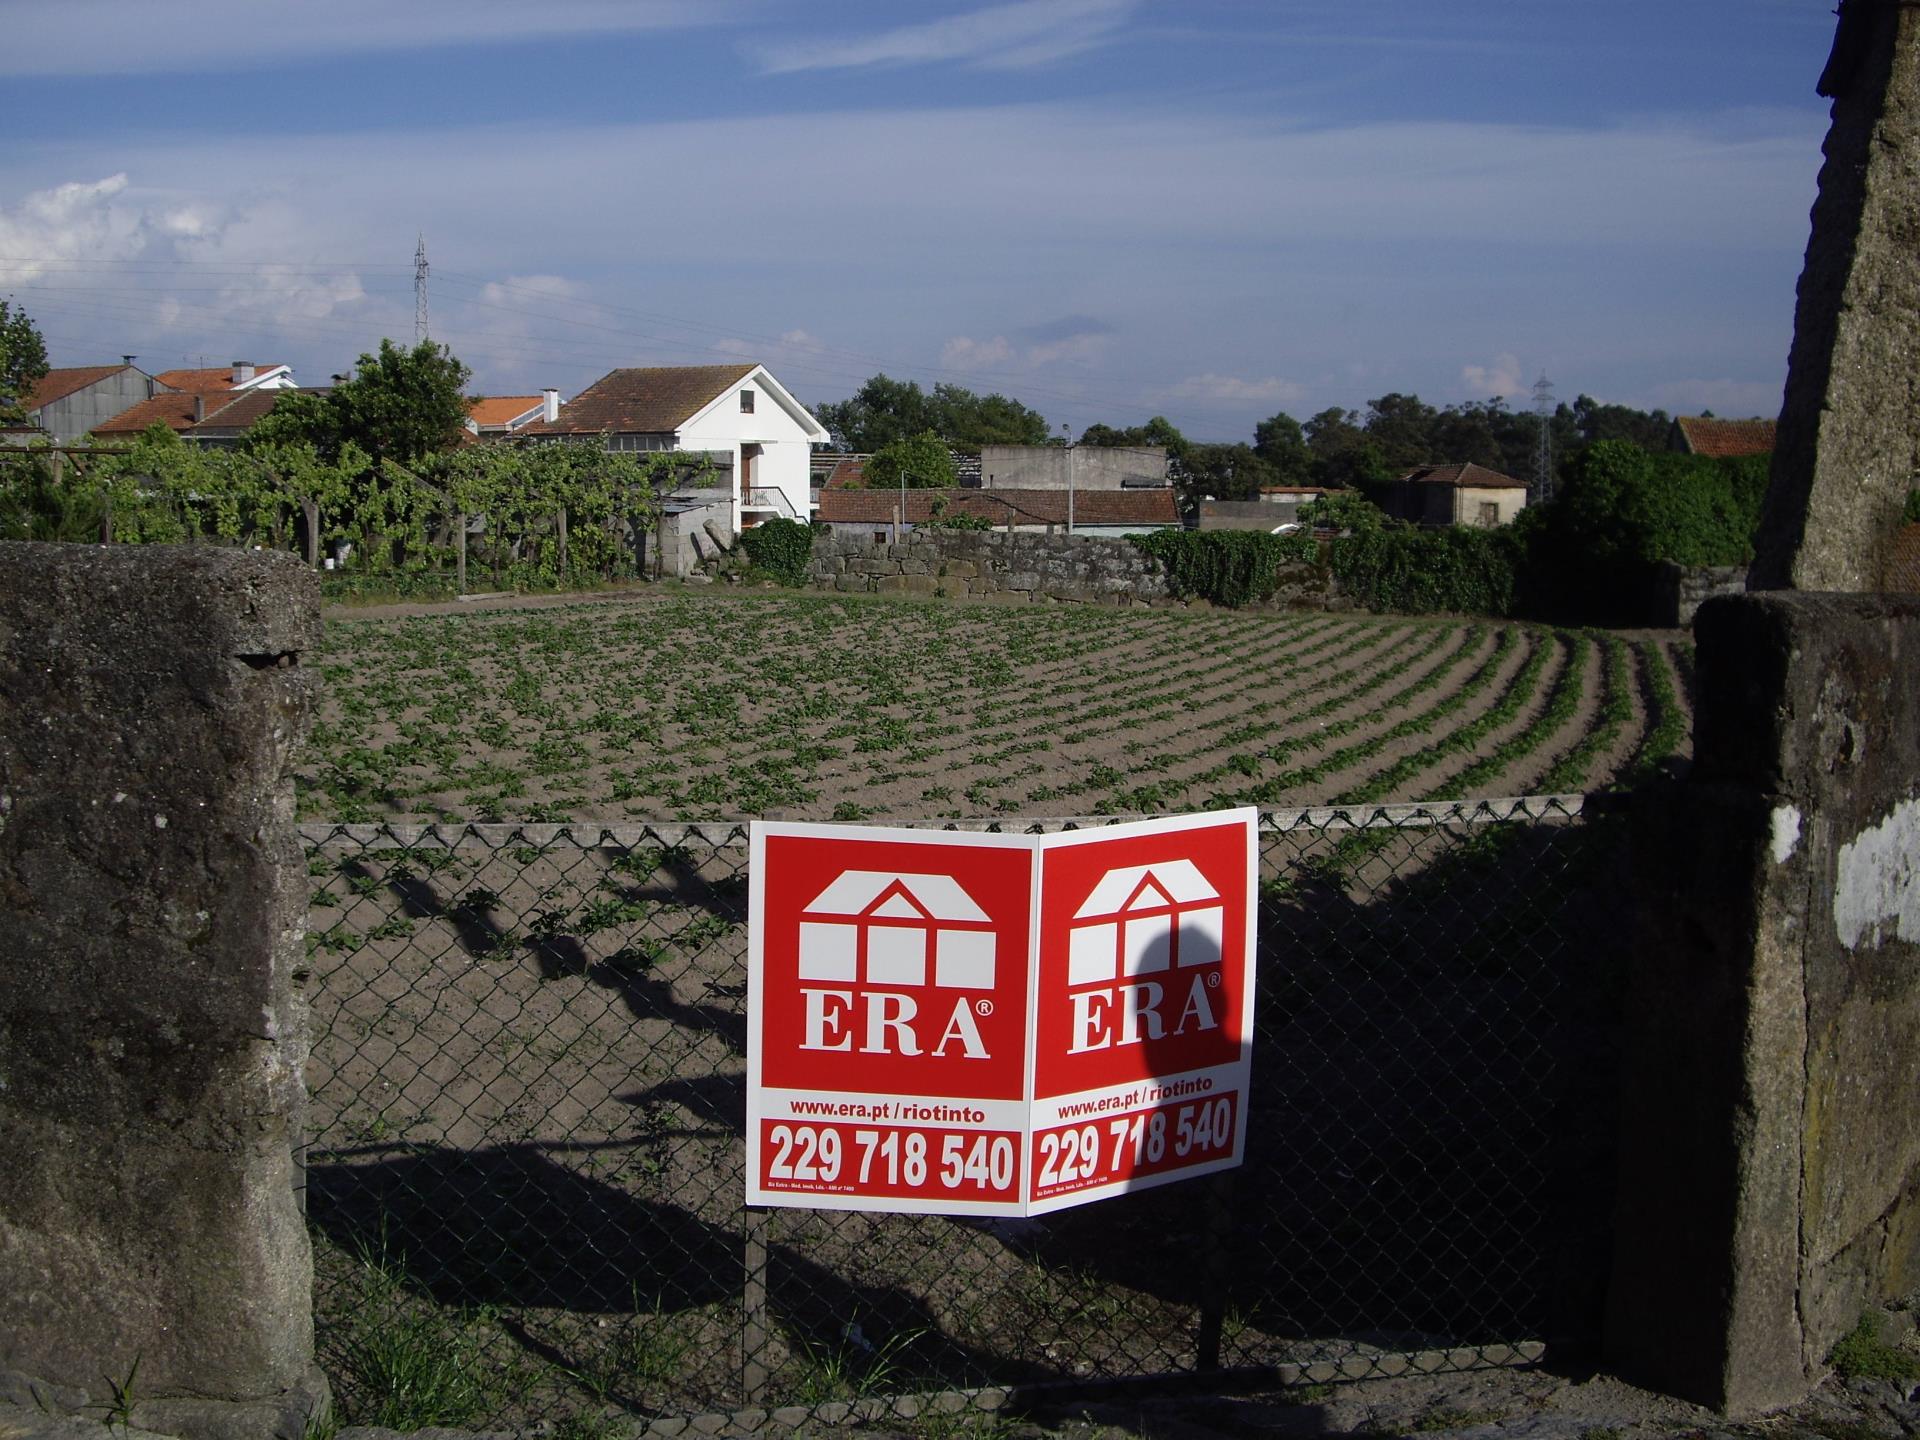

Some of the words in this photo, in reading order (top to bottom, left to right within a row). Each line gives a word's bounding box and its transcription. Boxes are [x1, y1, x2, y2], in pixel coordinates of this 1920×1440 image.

[769, 1125, 842, 1183] 229
[855, 1130, 928, 1188] 718
[940, 1135, 1014, 1192] 540
[1038, 1125, 1099, 1188] 229
[1110, 1111, 1167, 1172] 718
[1174, 1097, 1231, 1157] 540
